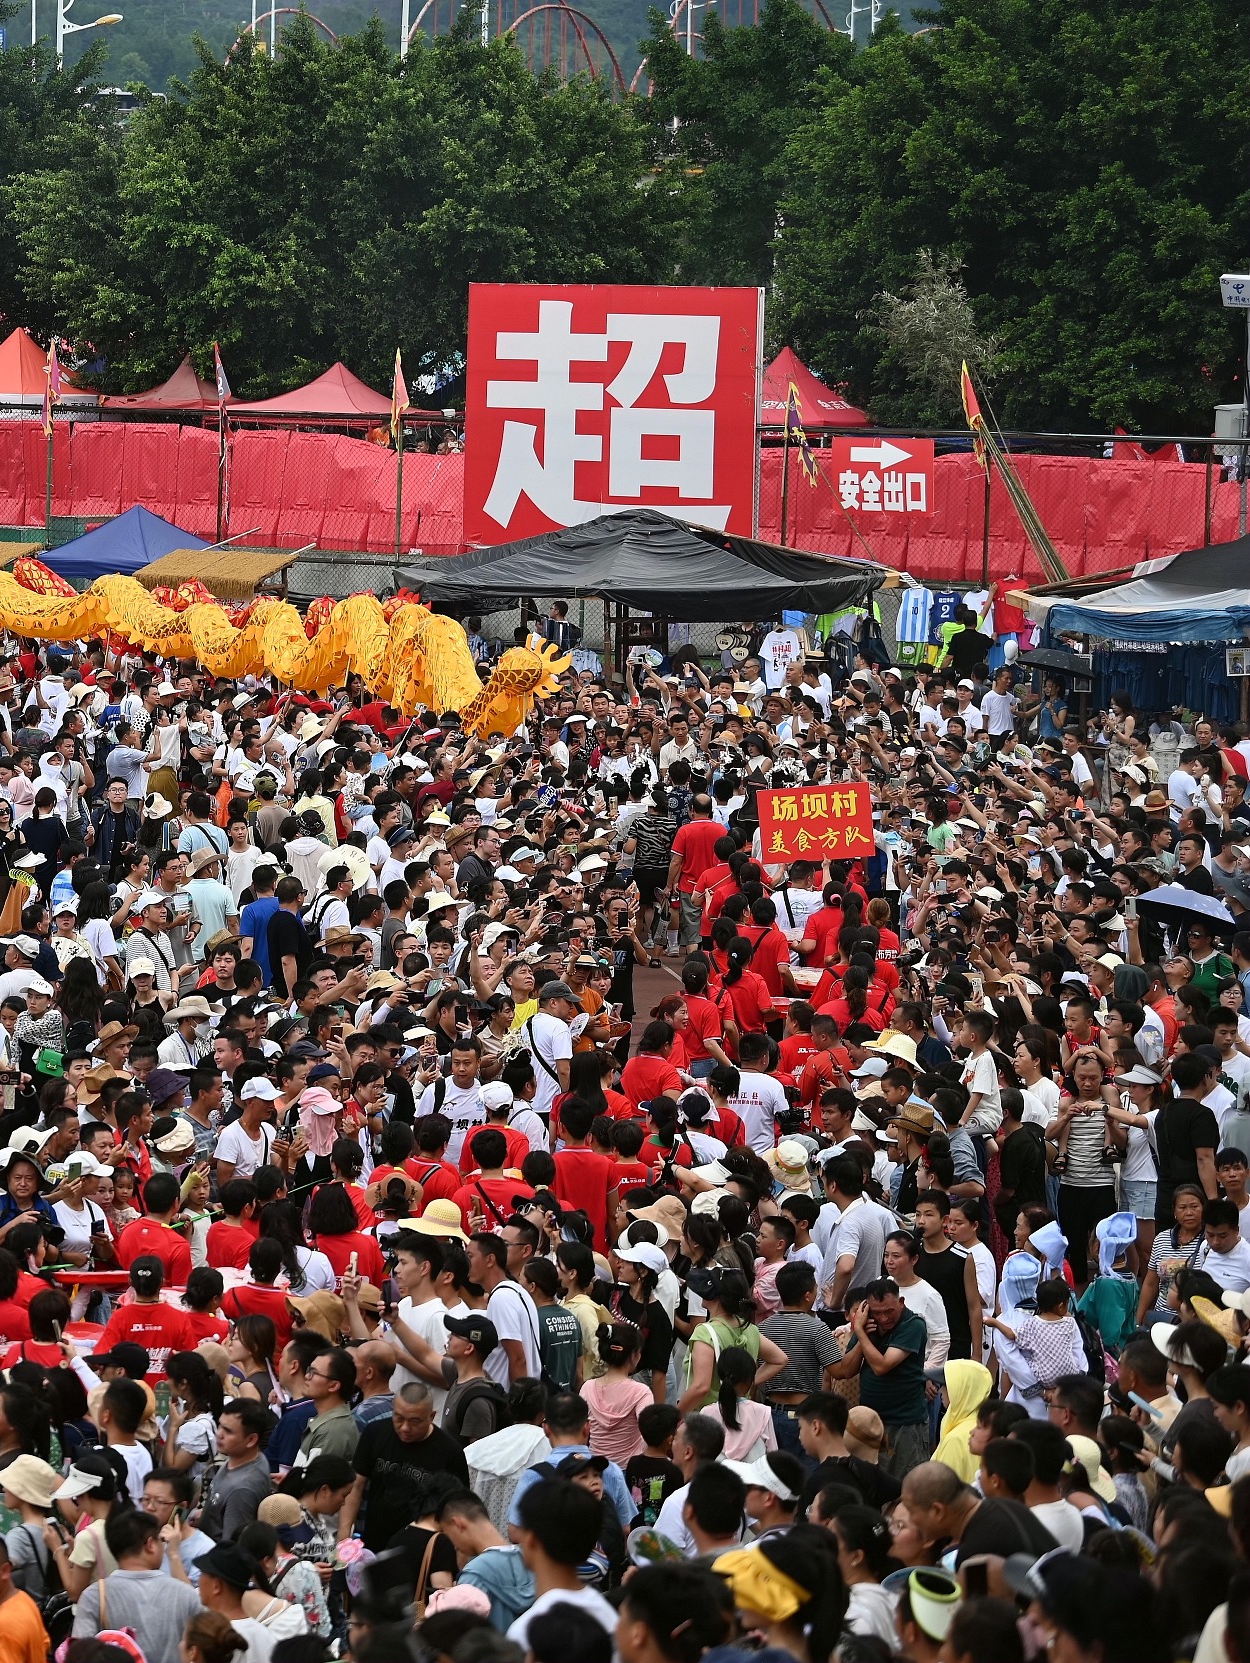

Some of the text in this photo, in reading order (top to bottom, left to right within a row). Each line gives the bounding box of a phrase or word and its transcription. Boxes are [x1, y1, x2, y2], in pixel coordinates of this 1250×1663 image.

[482, 299, 733, 532] 超
[838, 469, 927, 512] 安全出口
[940, 604, 950, 618] 2
[771, 789, 858, 821] 场坝村
[768, 826, 870, 855] 美食方队
[131, 1323, 145, 1332] JDL
[545, 1316, 577, 1327] CONSIDE
[549, 1323, 578, 1333] RTHINGS
